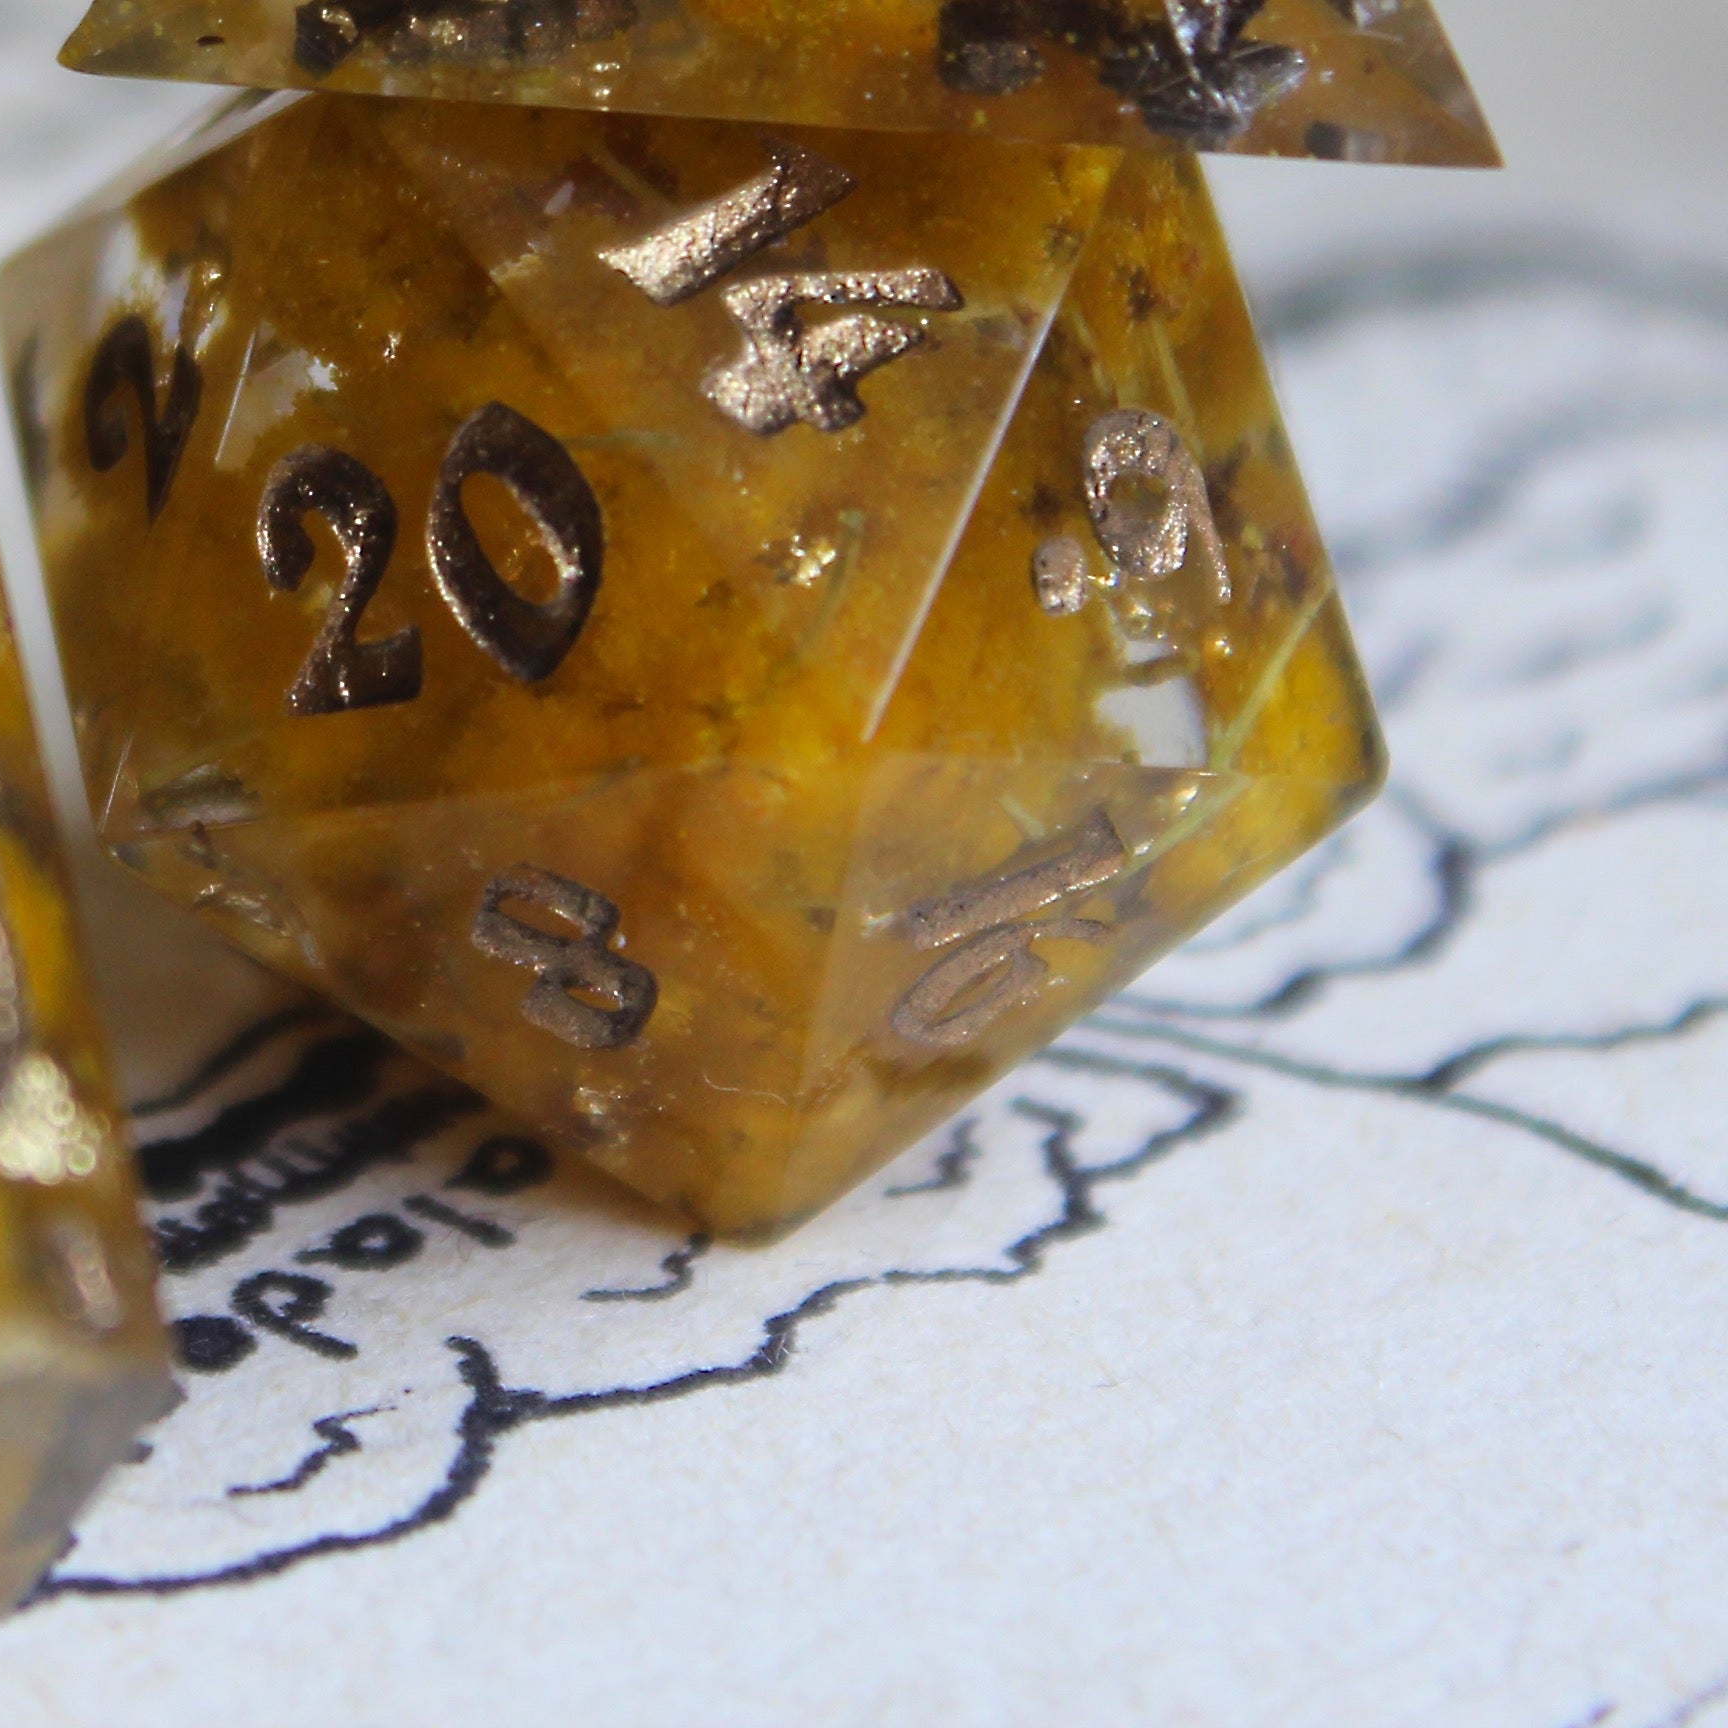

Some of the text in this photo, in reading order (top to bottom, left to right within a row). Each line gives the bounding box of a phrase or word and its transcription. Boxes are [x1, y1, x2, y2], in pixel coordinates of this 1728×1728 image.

[597, 134, 964, 438] 14
[255, 399, 604, 718] 20
[469, 868, 659, 1050] 8
